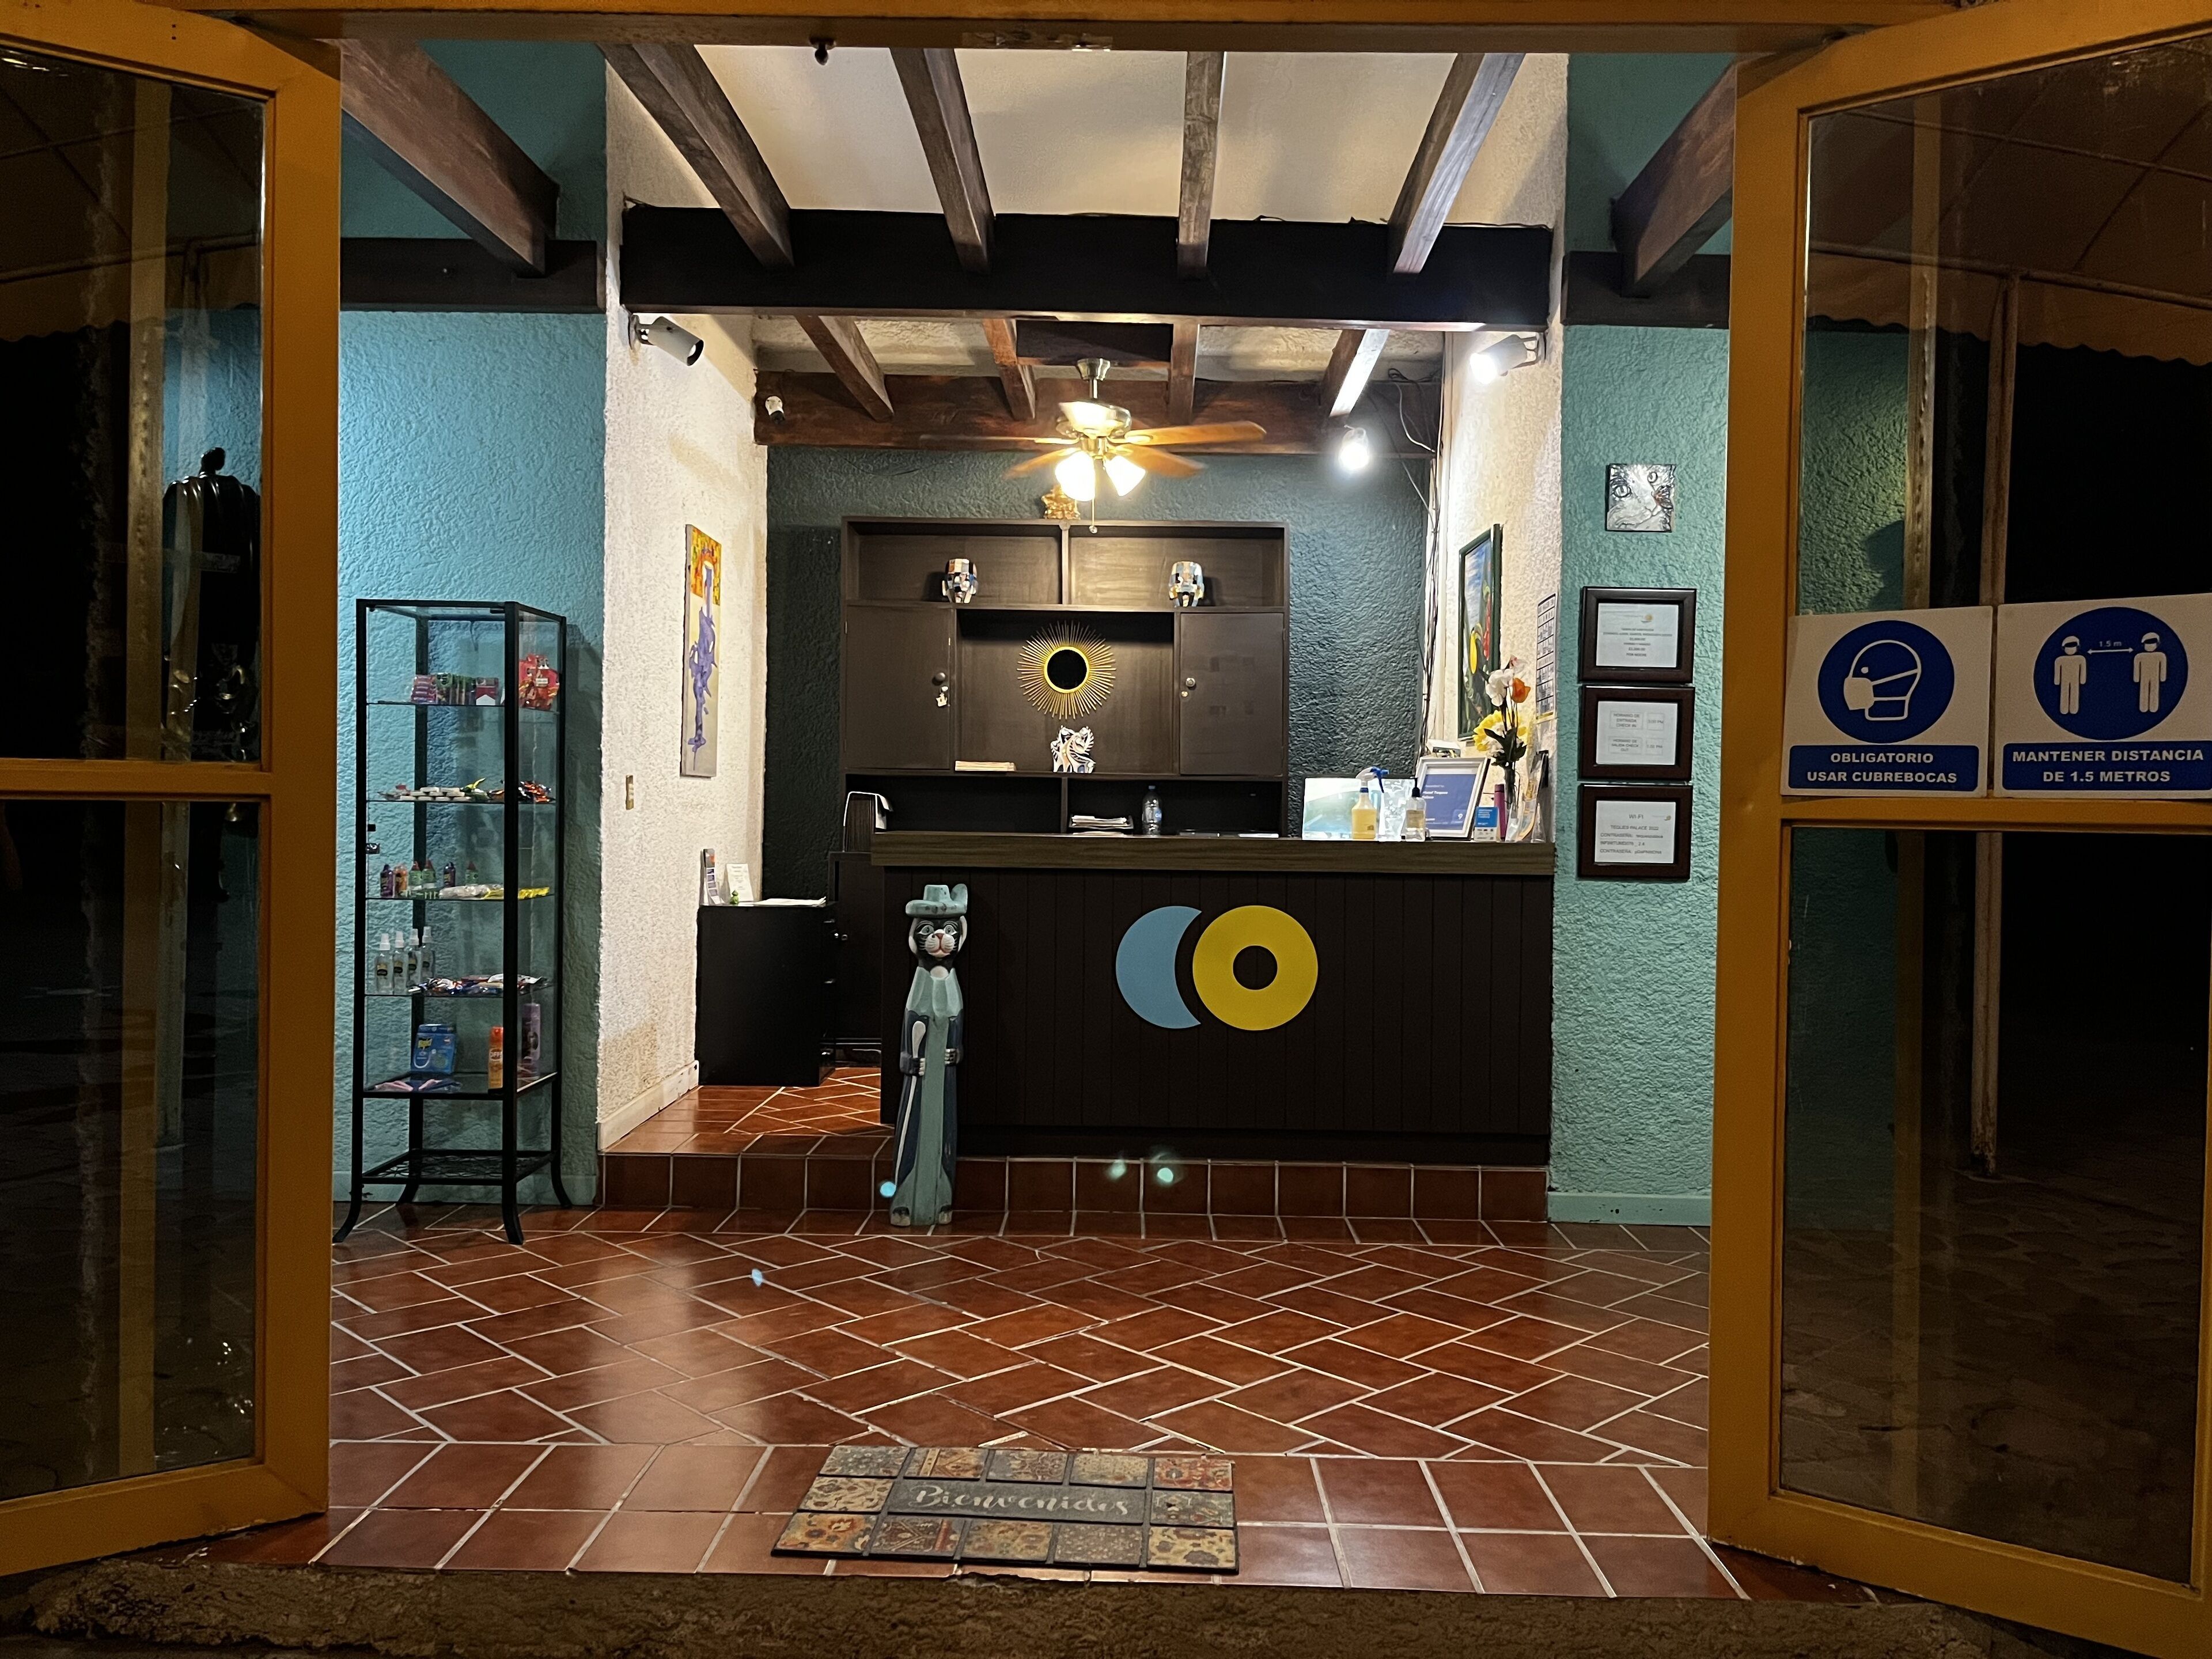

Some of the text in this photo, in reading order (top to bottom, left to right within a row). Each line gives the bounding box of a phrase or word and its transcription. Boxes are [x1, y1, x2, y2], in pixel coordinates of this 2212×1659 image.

[1830, 752, 1934, 763] OBLIGATORIO
[2013, 749, 2204, 762] MANTENER DISTANCIA
[1807, 771, 1957, 783] USAR CUBREBOCAS
[2043, 771, 2171, 782] DE 1.5 METROS
[908, 1484, 1128, 1516] Bienvenidos
